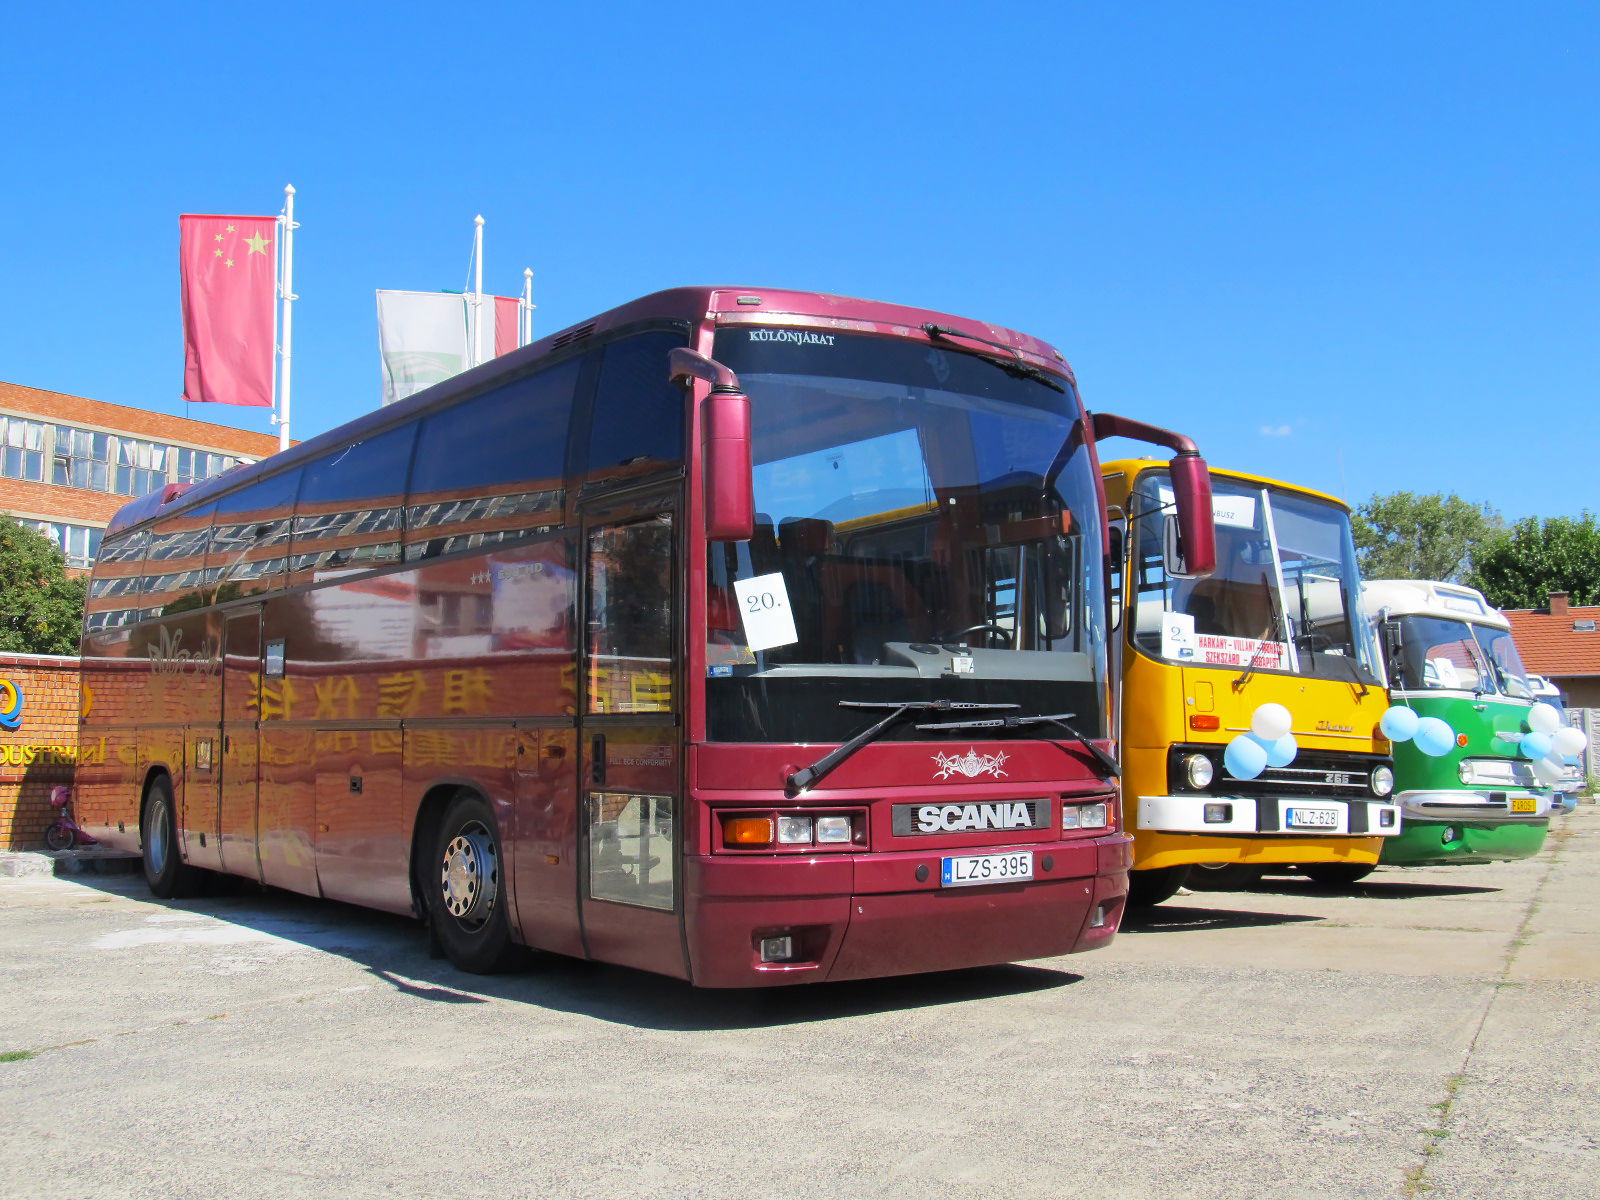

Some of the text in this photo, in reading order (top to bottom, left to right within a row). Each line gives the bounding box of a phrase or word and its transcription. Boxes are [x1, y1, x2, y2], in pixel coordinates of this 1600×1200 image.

[748, 328, 835, 346] KÜLÖNJÁRAT
[747, 591, 781, 613] 20.
[1170, 626, 1187, 642] 2.
[917, 802, 1033, 833] SCANIA
[1294, 810, 1336, 825] NLZ-628
[956, 855, 1029, 880] LZS-395
